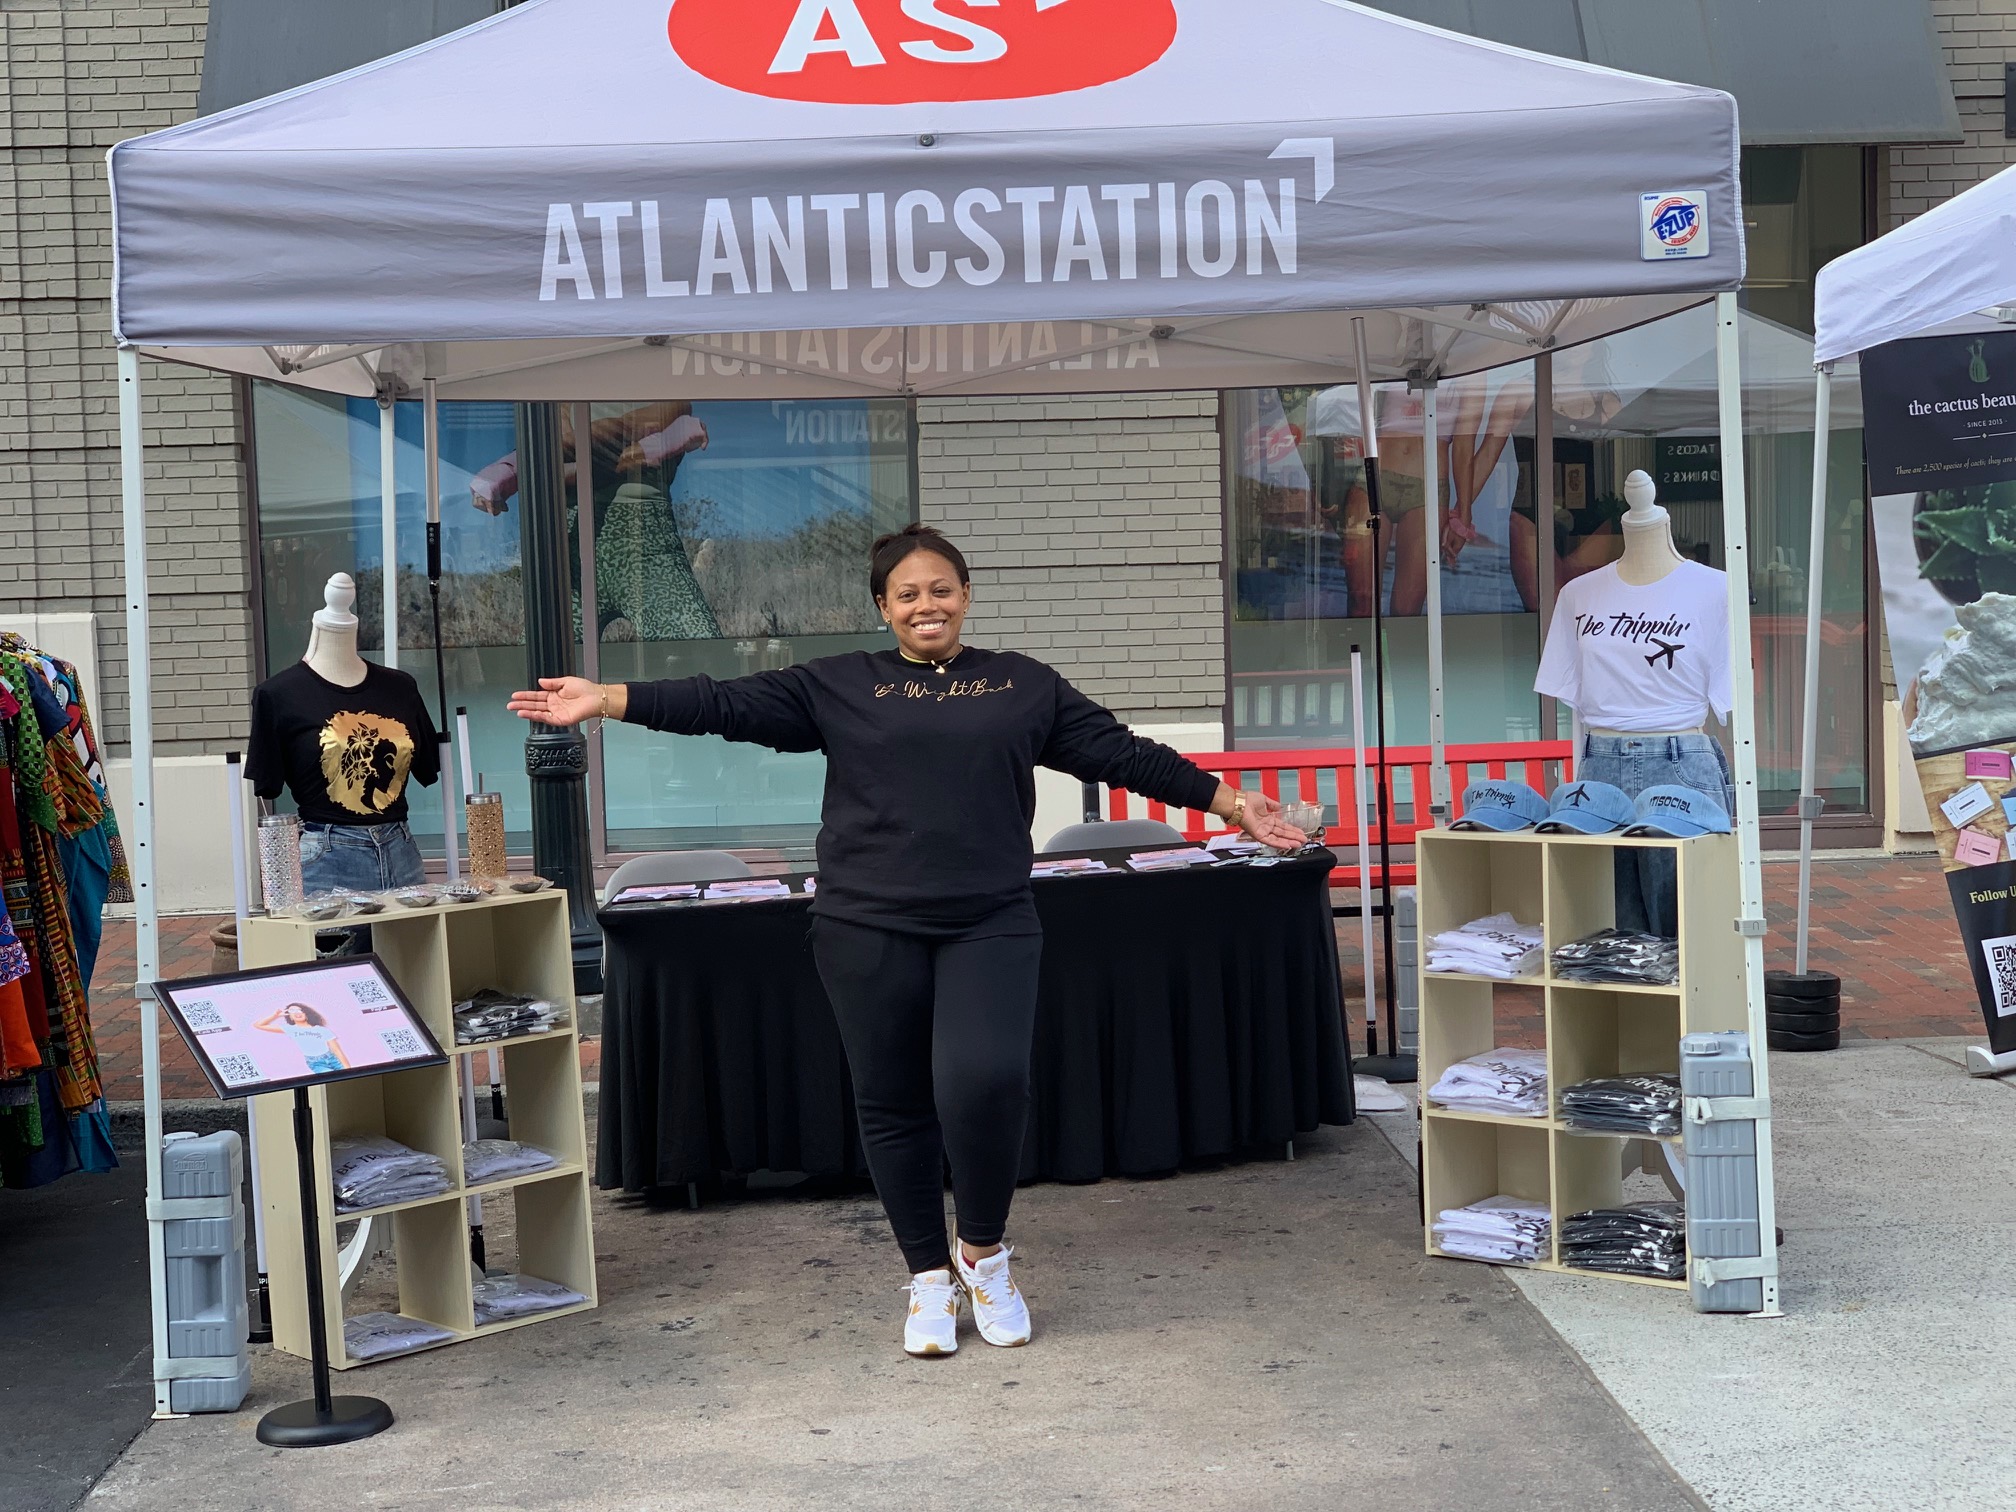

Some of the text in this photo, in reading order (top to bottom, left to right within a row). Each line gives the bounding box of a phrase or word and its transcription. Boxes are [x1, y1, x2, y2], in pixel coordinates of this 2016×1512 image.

[538, 178, 1298, 302] ATLANTICSTATION
[1908, 400, 1932, 416] the
[1934, 398, 1979, 413] cactus
[1966, 420, 1987, 428] SINCE
[1895, 465, 1911, 475] There
[1943, 461, 1962, 471] species
[1988, 455, 2001, 465] they
[1582, 615, 1606, 637] be
[1968, 890, 2008, 904] Follow
